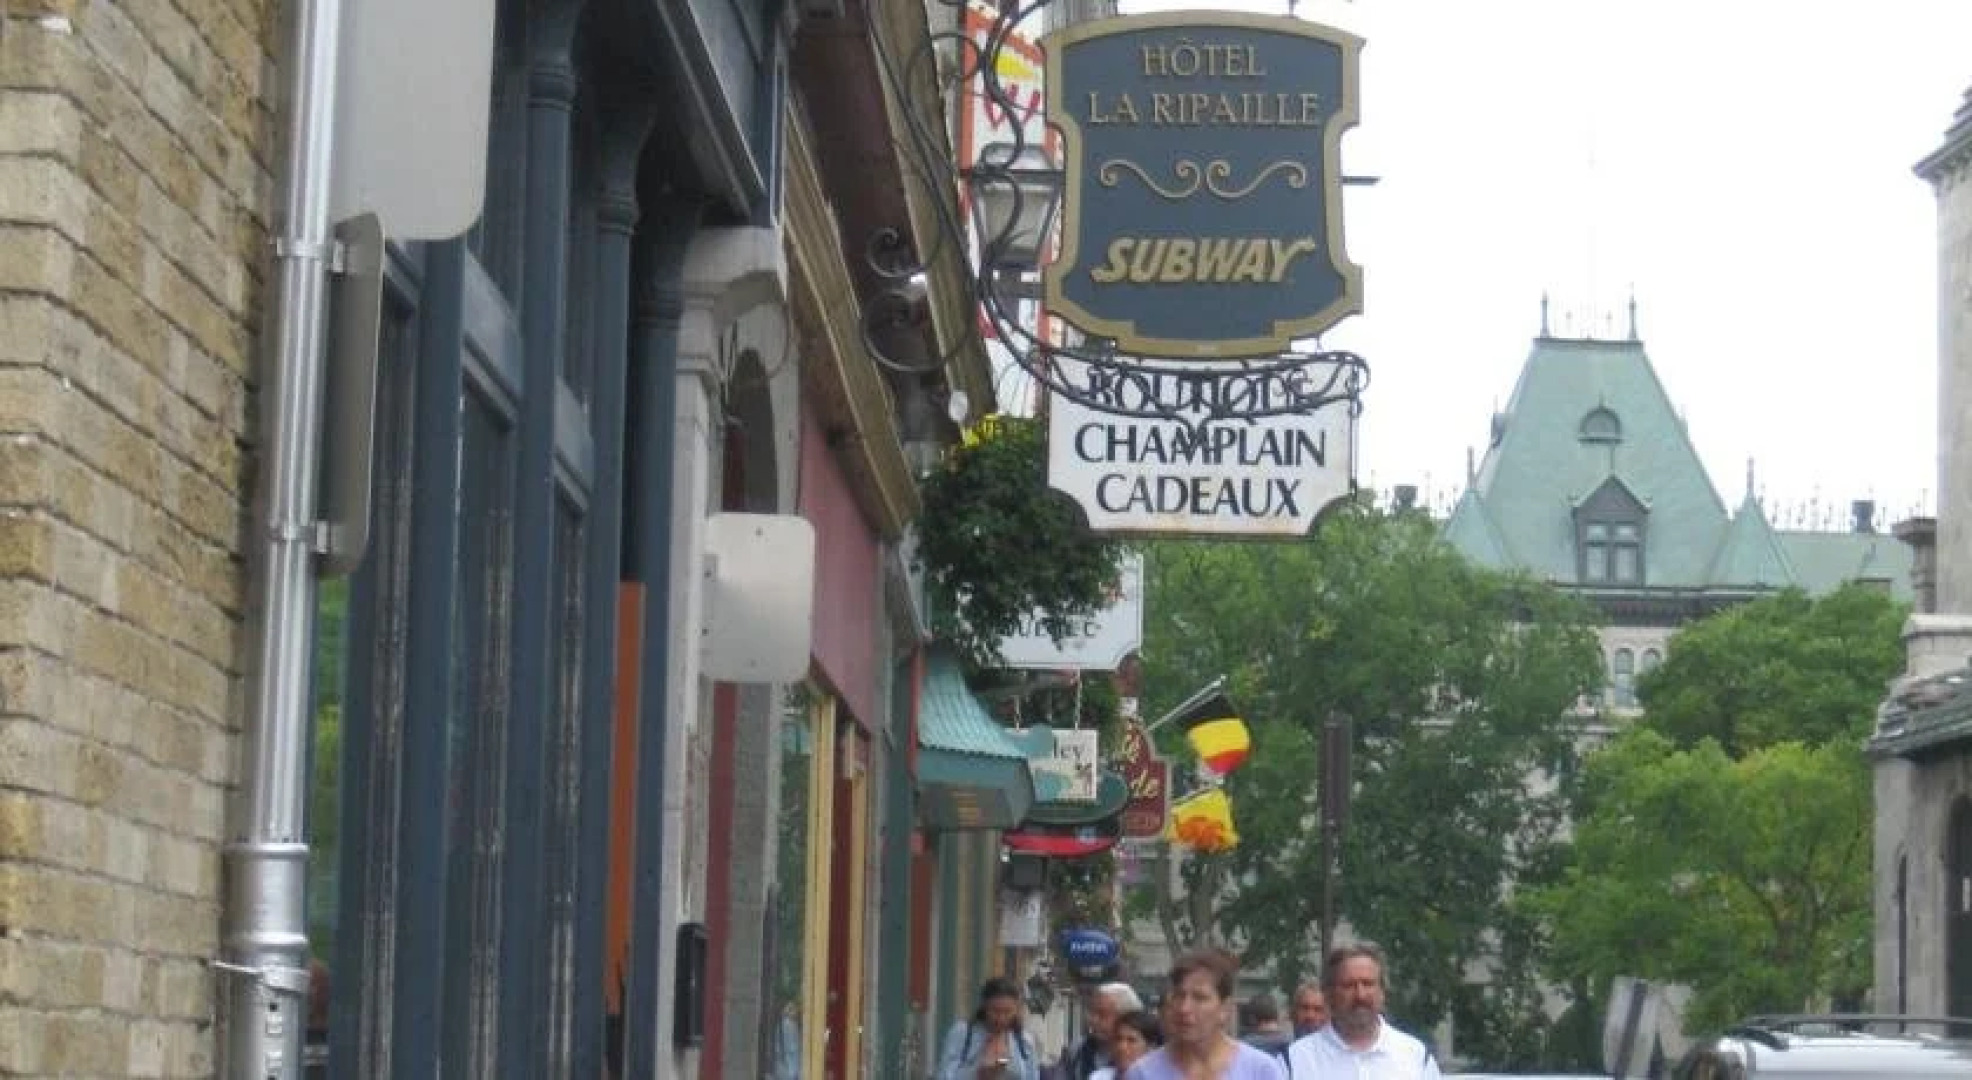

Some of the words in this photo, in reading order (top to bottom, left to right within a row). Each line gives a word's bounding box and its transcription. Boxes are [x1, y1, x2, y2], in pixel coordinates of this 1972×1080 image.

[1142, 37, 1266, 76] HÔTEL
[1088, 91, 1139, 124] LA
[1153, 92, 1319, 125] RIPAILLE
[1090, 236, 1316, 284] SUBWAY
[1074, 423, 1327, 467] CHAMPLAIN
[1096, 473, 1302, 517] CADEAUX
